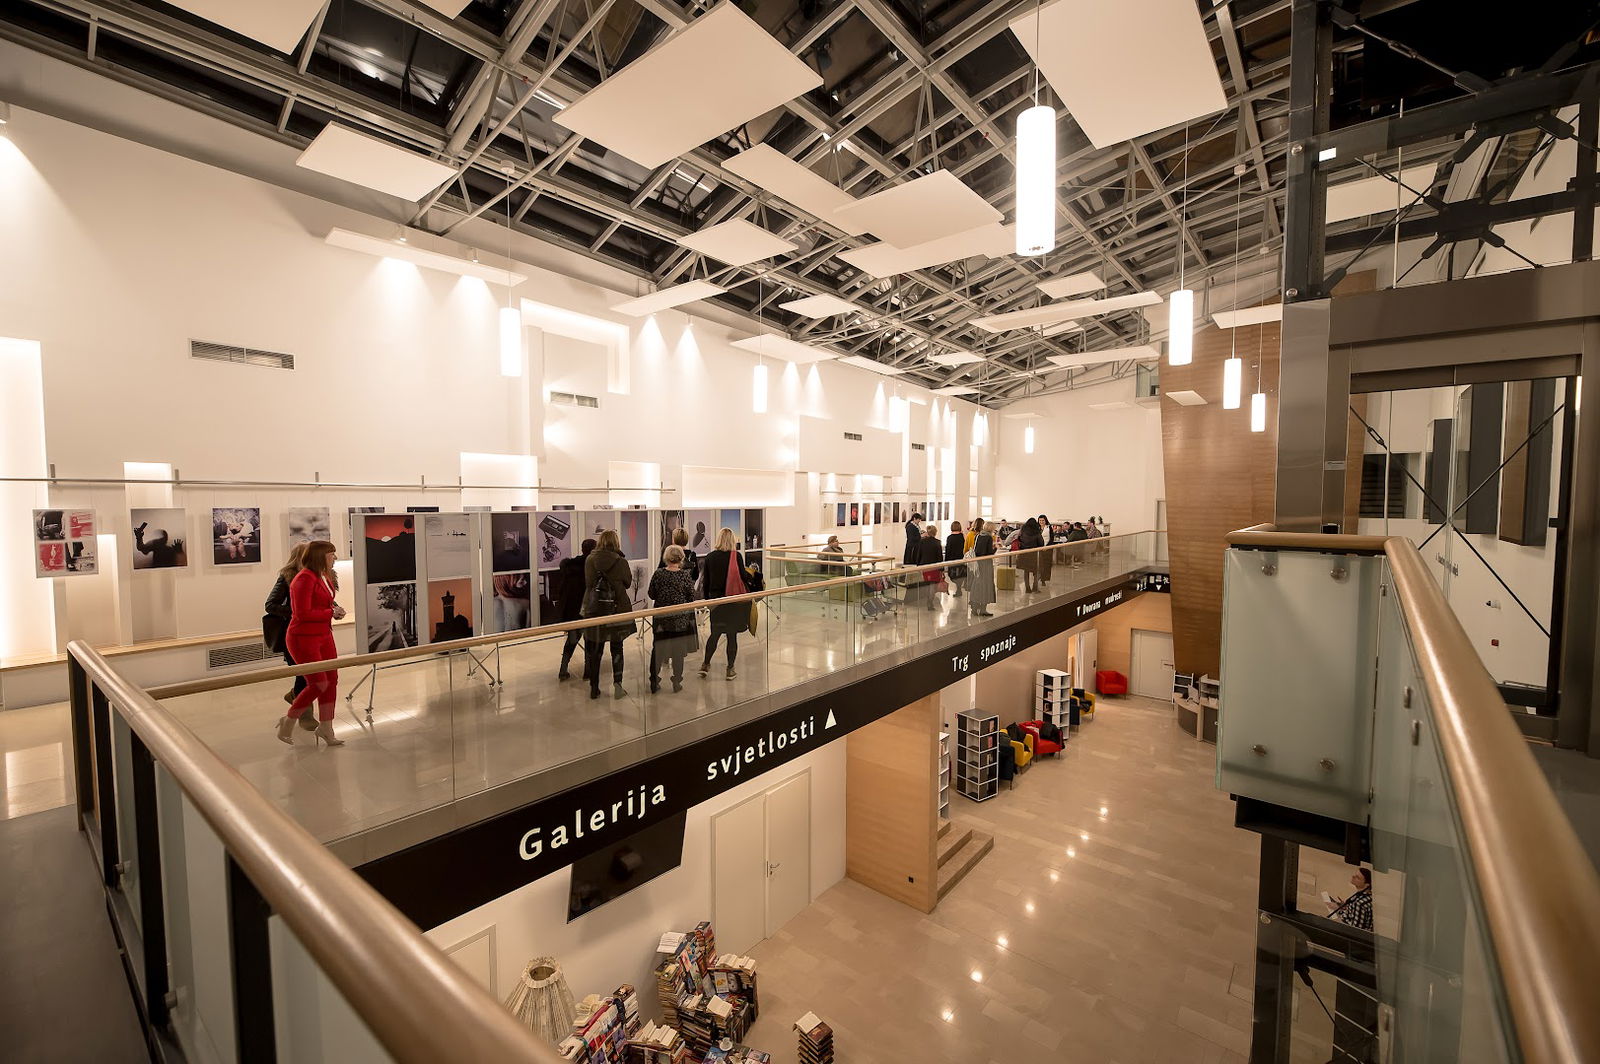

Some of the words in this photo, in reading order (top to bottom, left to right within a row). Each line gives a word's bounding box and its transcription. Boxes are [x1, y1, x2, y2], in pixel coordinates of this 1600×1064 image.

[952, 655, 969, 672] Trg
[980, 635, 1016, 661] spoznaje
[518, 784, 667, 861] Galerija
[706, 716, 815, 780] svjetlosti
